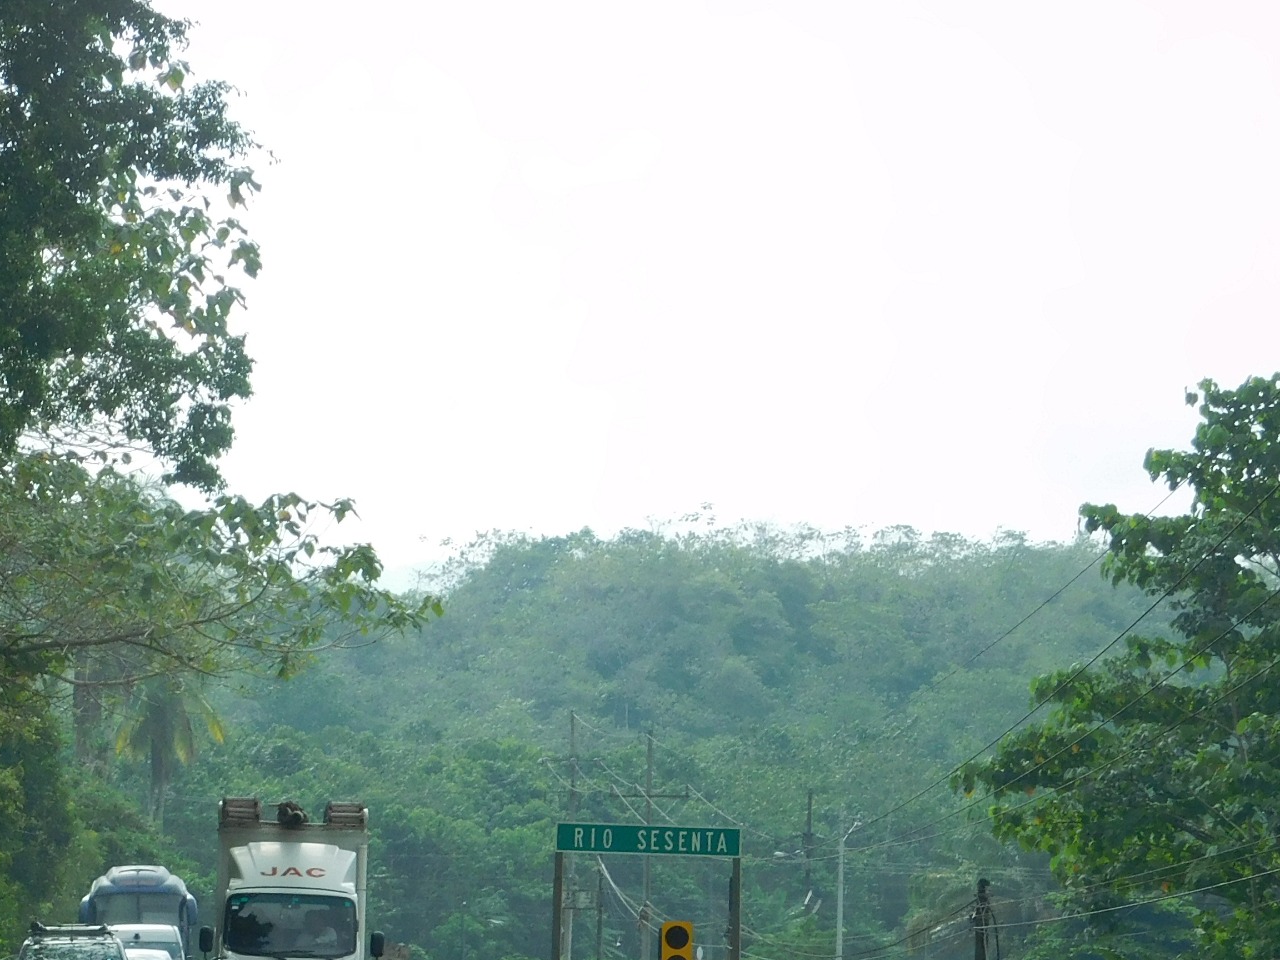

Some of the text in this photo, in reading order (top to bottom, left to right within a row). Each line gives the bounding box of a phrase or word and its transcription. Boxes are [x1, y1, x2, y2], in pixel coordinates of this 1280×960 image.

[574, 827, 728, 853] RIO SESENTA
[260, 866, 327, 878] JAC
